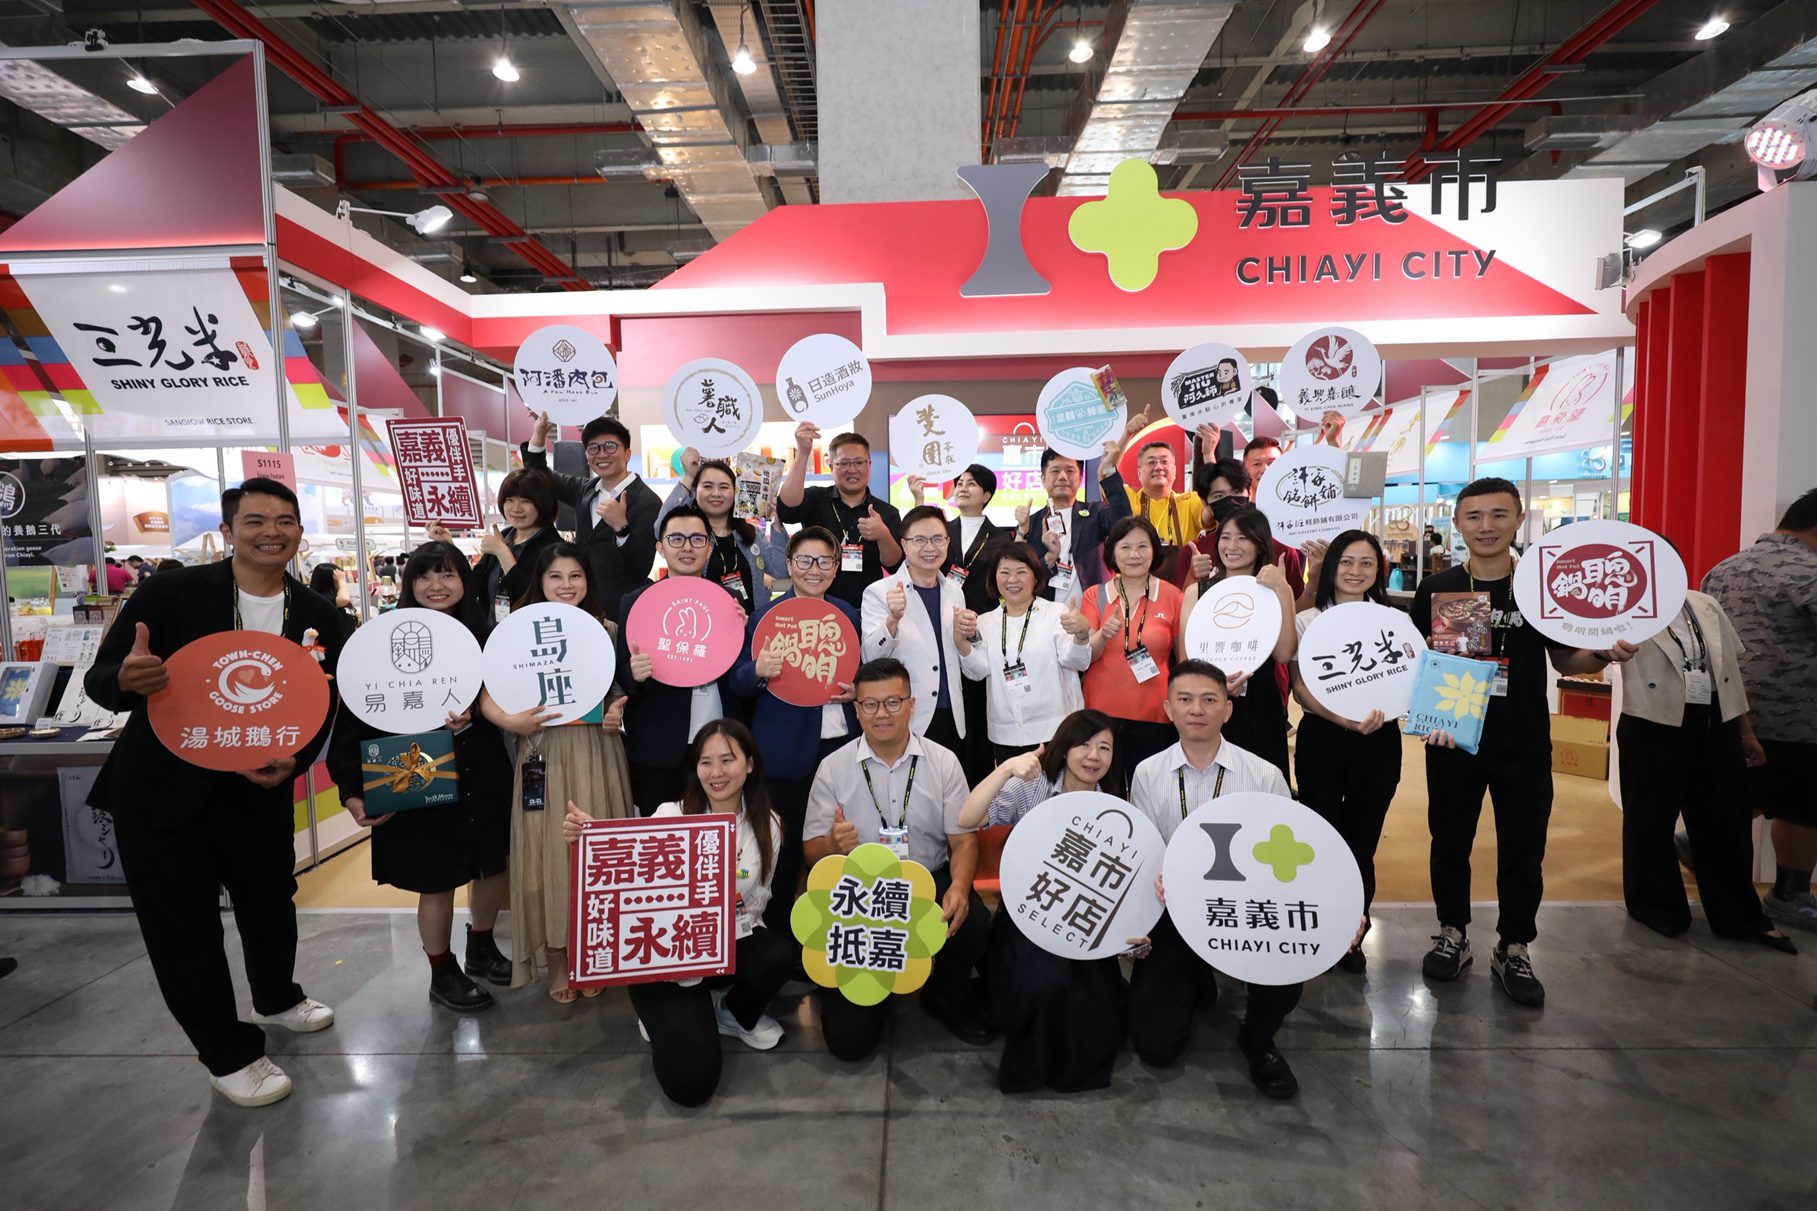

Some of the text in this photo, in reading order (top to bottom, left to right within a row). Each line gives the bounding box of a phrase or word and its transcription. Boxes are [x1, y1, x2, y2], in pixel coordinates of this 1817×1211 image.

[1236, 148, 1502, 229] 嘉義市
[1236, 249, 1496, 285] CHIAYI CITY
[111, 376, 250, 390] SHINY GLORY RICE
[519, 368, 613, 389] 阿潘肉包
[807, 360, 863, 393] 日造酒妝
[1184, 372, 1215, 386] MASTER
[1189, 379, 1211, 392] JIU
[814, 380, 855, 402] SunHoya
[1183, 385, 1218, 404] 阿久師
[206, 417, 225, 425] RICE
[226, 416, 254, 425] STORE
[396, 430, 447, 463] 嘉義
[1002, 436, 1043, 444] CHIAYI
[257, 459, 281, 468] S1115
[445, 428, 466, 481] 優伴手
[404, 467, 426, 519] 好味道
[427, 485, 473, 518] 永續
[672, 598, 709, 613] SAINT PAUL
[657, 637, 707, 658] 聖保羅
[212, 650, 284, 672] TOWN-CHEN
[513, 660, 554, 669] SHIMAZA
[365, 676, 458, 691] YI CHIA REN
[1326, 664, 1408, 694] SHINY GLORY RICE
[209, 691, 284, 714] GOOSE STORE
[365, 688, 461, 714] 易嘉人
[1414, 723, 1433, 733] RIC
[1416, 713, 1458, 729] CHIAYI
[180, 725, 301, 749] 湯城鵝行
[1072, 816, 1138, 859] CHIAYI
[587, 834, 686, 887] 嘉義
[694, 829, 720, 905] 優伴手
[1051, 828, 1132, 890] 嘉市
[830, 877, 910, 921] 永續
[1026, 871, 1108, 937] 好店
[1017, 903, 1089, 949] SELECT
[1205, 897, 1319, 931] 嘉義市
[586, 893, 615, 975] 好味道
[621, 911, 719, 965] 永續
[1208, 938, 1320, 955] CHIAYI CITY
[827, 925, 908, 970] 抵嘉
